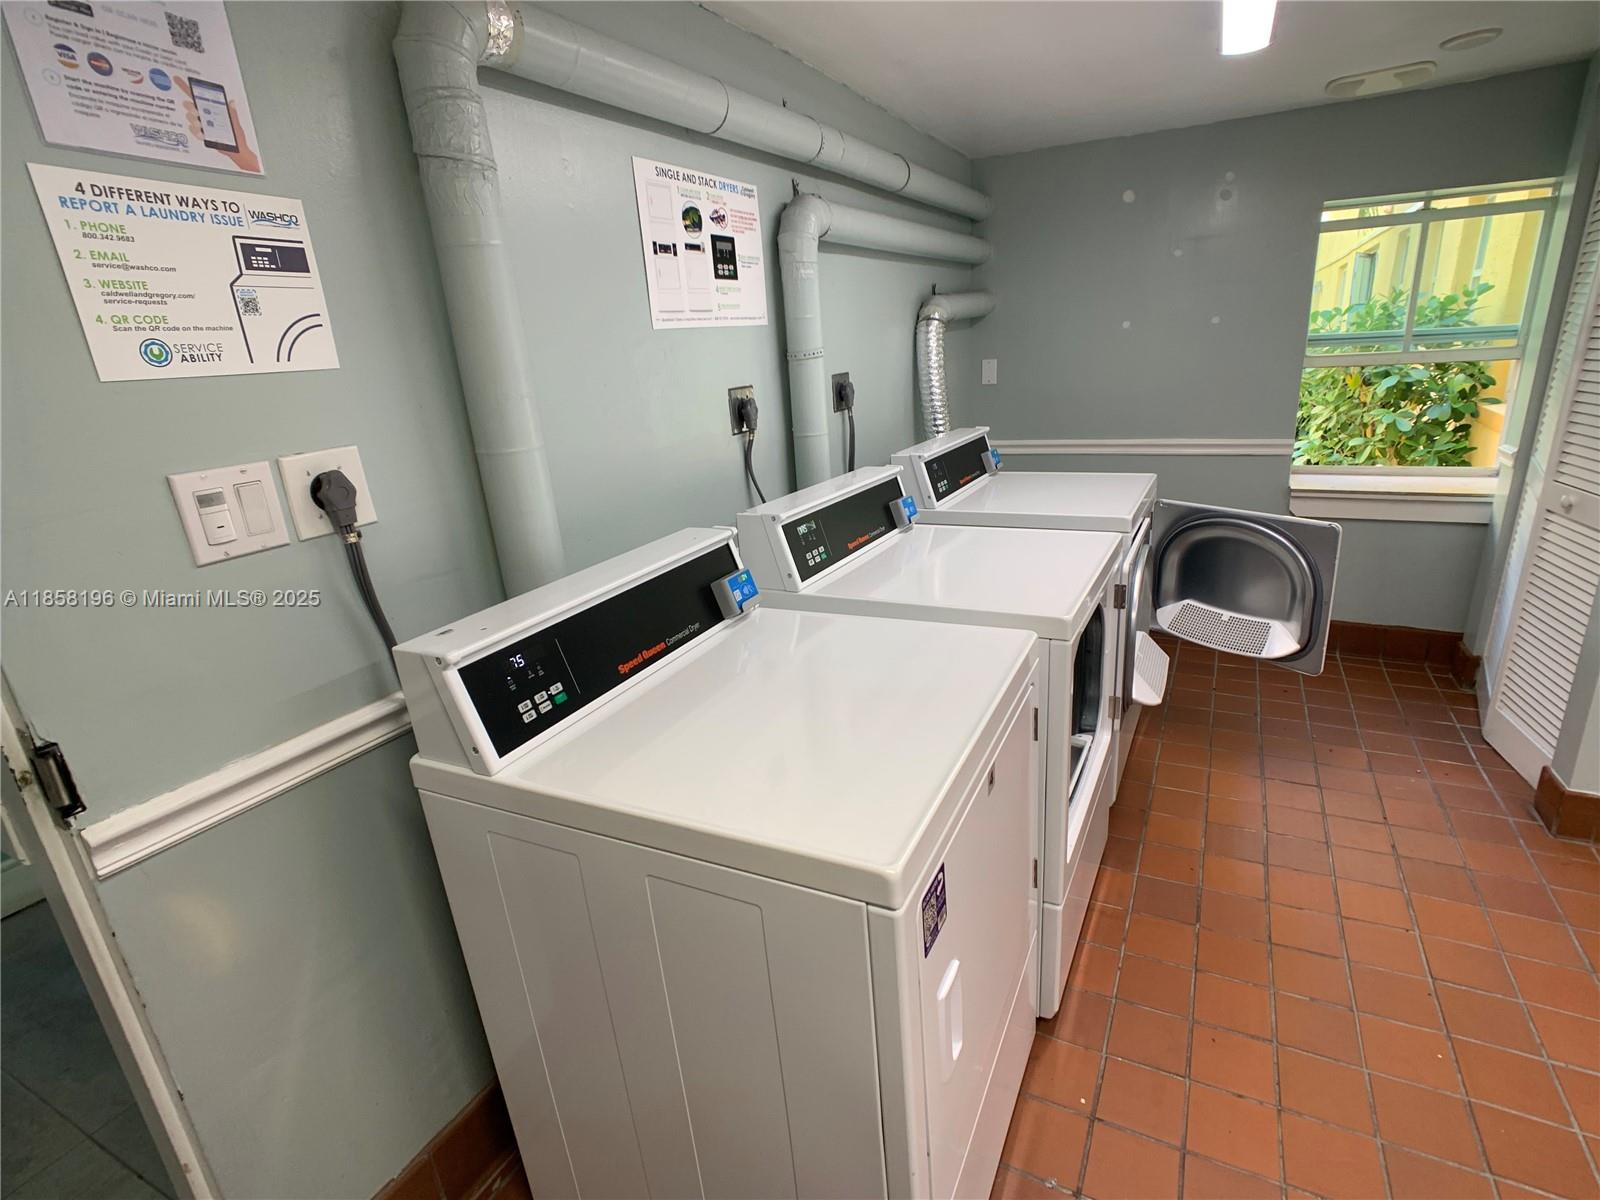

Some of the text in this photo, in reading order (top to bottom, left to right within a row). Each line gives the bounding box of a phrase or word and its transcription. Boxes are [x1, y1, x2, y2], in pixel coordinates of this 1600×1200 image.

[55, 50, 78, 61] VISA
[655, 166, 680, 182] SINGLE
[682, 172, 697, 184] AND
[698, 176, 718, 189] STACK
[718, 180, 738, 194] DRYERS
[75, 182, 240, 214] 4 DIFFERENT WAYS TO
[58, 196, 244, 227] REPORT A LAUNDRY ISSUE
[248, 210, 300, 226] WASHCO
[64, 219, 127, 234] 1. PHONE
[73, 249, 130, 262] 2. EMAIL
[92, 262, 176, 272] service@washco.com
[84, 278, 148, 290] 3. WEBSITE
[100, 290, 195, 300] caldwellandgregory.com/
[104, 298, 168, 306] service-requests
[96, 314, 169, 324] 4. QR CODE
[173, 343, 224, 354] SERVICE
[180, 353, 222, 363] ABILITY
[510, 654, 524, 668] 75
[618, 652, 643, 674] Speed
[642, 641, 667, 660] Queen
